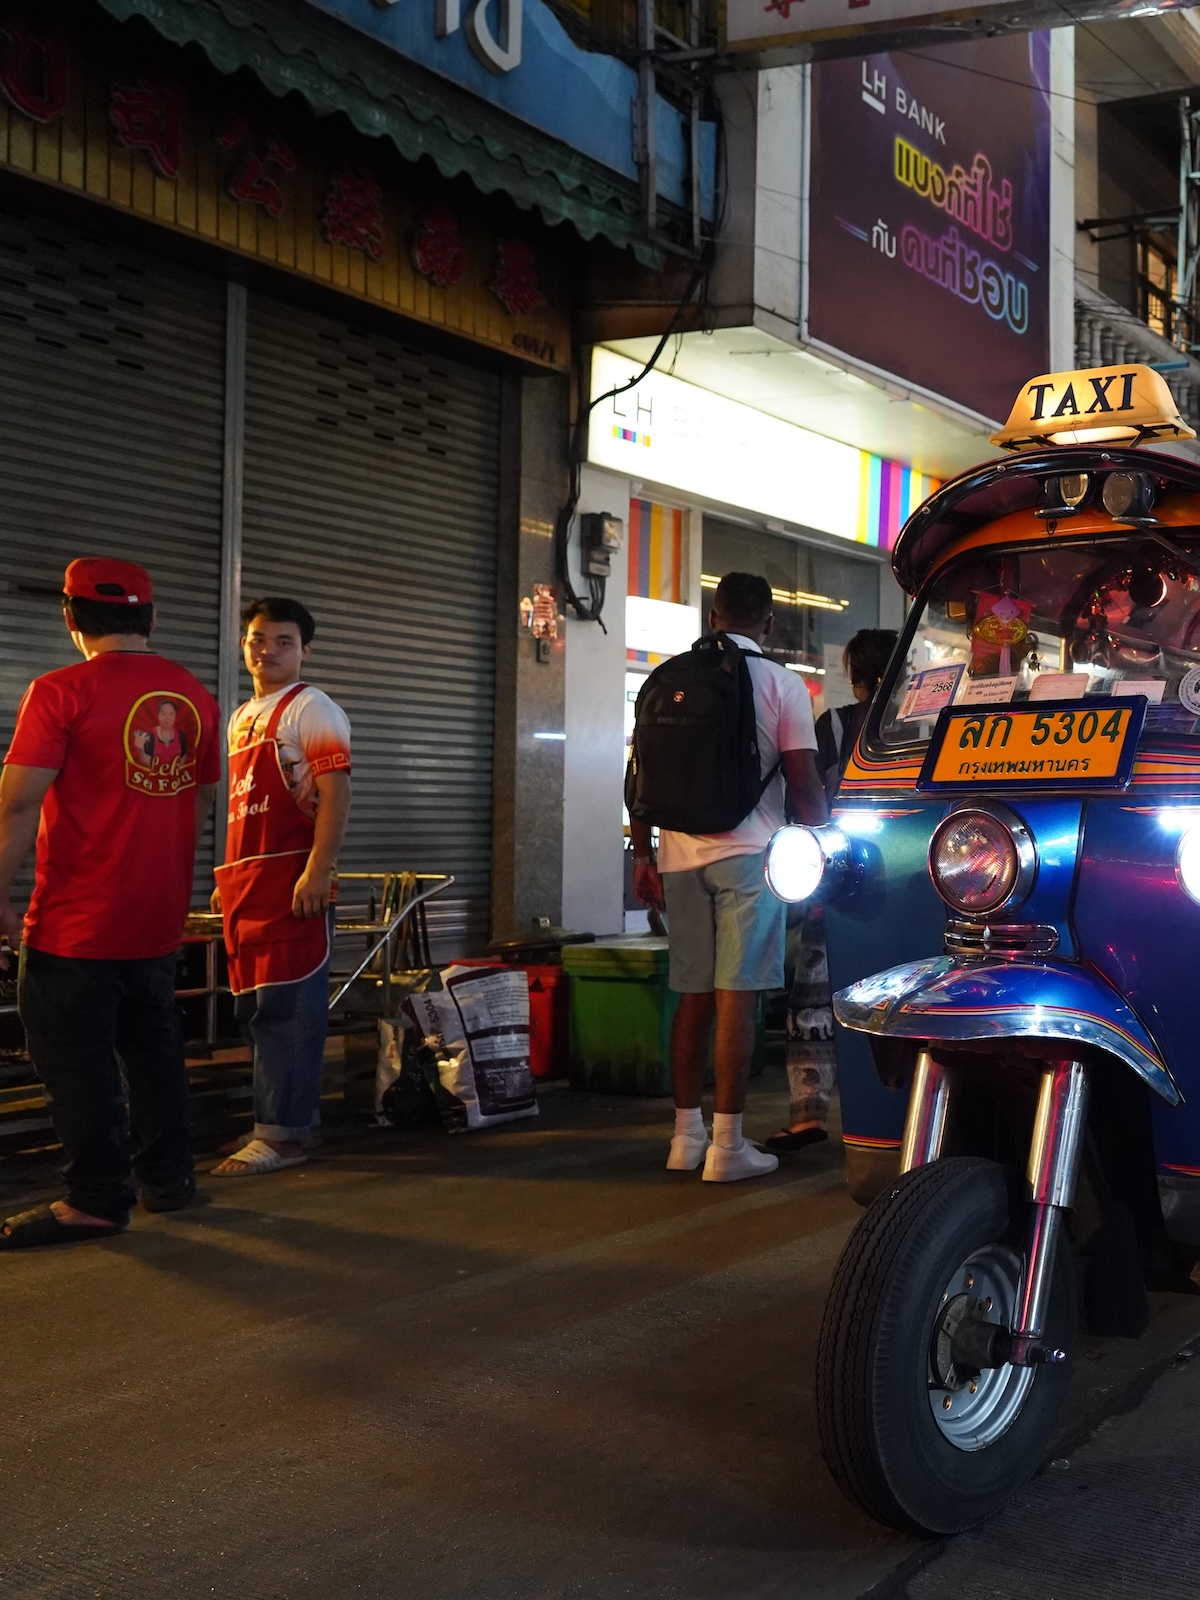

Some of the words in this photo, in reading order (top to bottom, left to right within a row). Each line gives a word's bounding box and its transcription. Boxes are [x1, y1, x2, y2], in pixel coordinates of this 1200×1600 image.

[862, 61, 887, 99] LH
[895, 87, 946, 145] BANK
[872, 219, 896, 258] กับ
[613, 382, 653, 427] LH
[1027, 373, 1137, 421] TAXI
[932, 681, 953, 693] 2568
[959, 715, 1013, 749] สก
[1031, 709, 1122, 746] 5304
[150, 755, 183, 777] Lek
[958, 758, 1091, 780] กรุงเทพมหานคร
